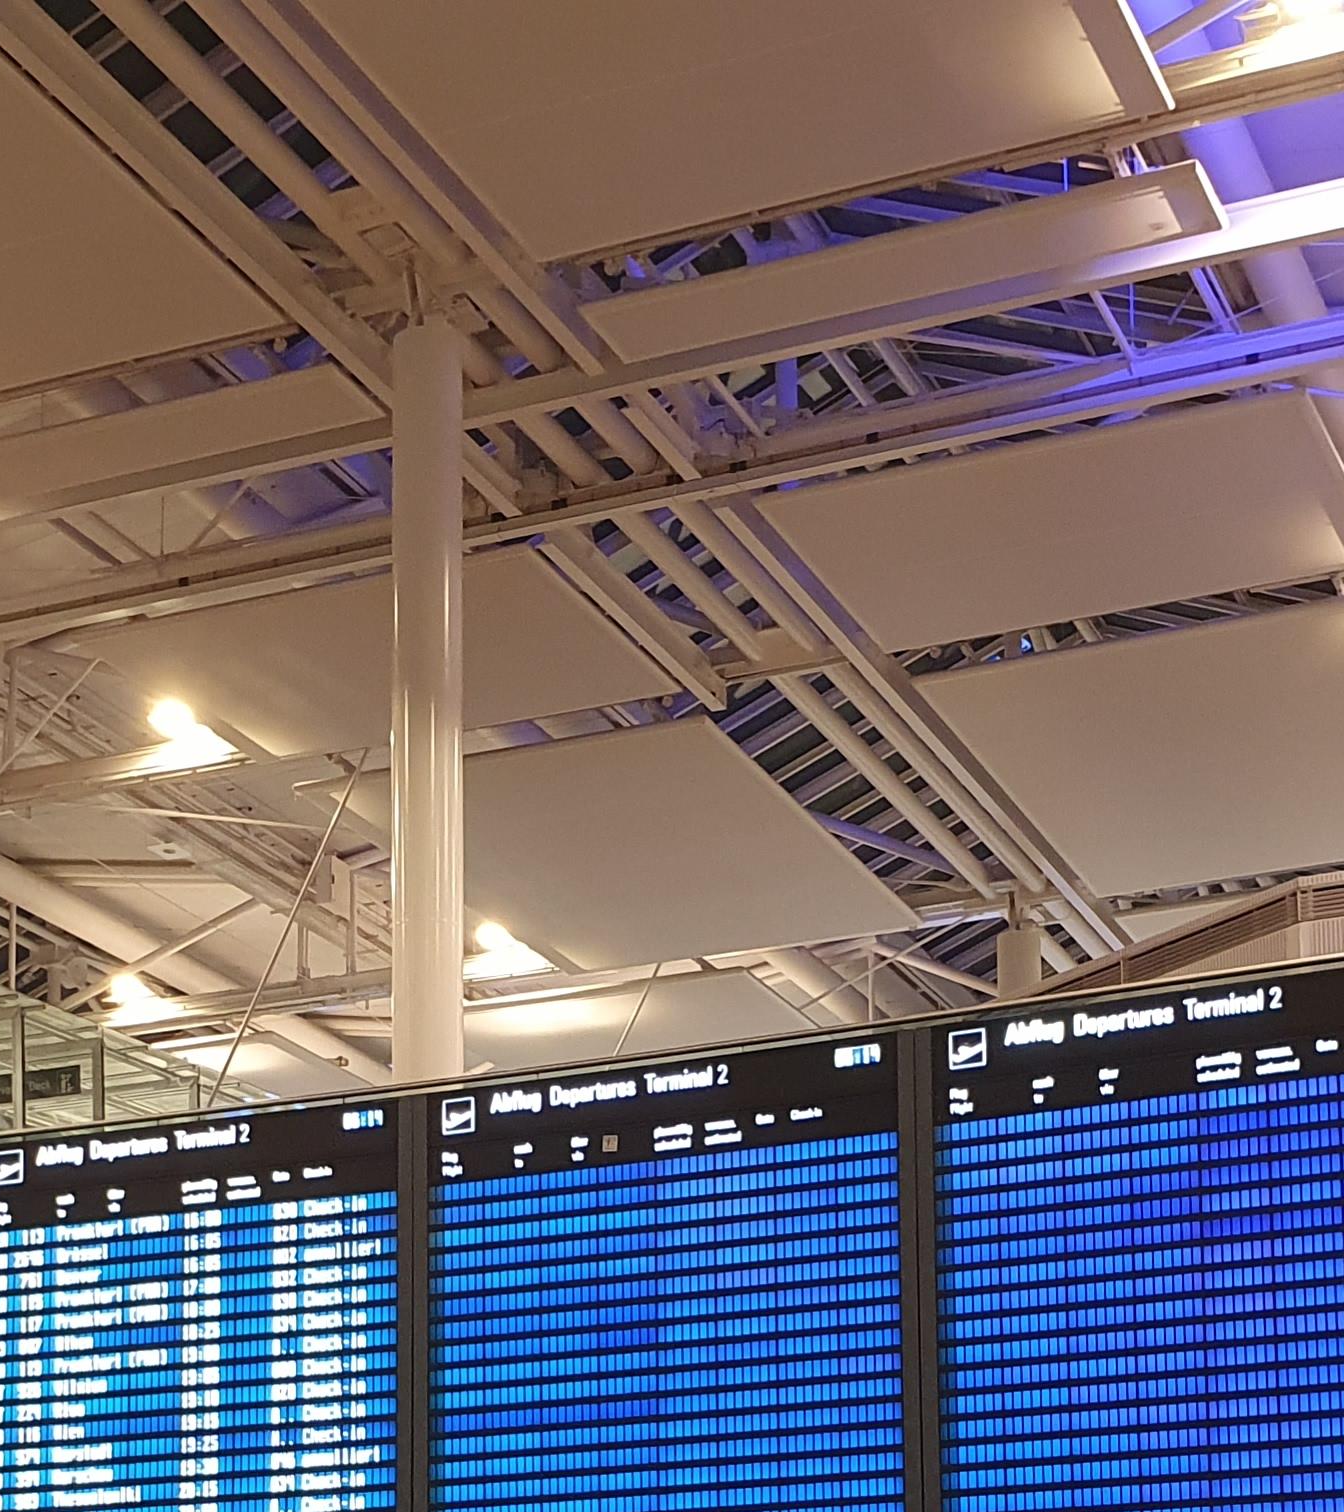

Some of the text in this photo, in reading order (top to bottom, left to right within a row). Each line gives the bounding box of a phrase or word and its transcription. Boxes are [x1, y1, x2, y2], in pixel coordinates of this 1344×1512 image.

[1005, 1020, 1064, 1045] Abflug
[1074, 1007, 1174, 1037] Departures
[1183, 989, 1263, 1019] Terminal
[1270, 987, 1281, 1008] 2
[550, 1081, 636, 1107] Departures
[644, 1066, 712, 1092] Terminal
[718, 1065, 728, 1084] 2
[174, 1122, 235, 1149] Terminal
[240, 1124, 249, 1142] 2
